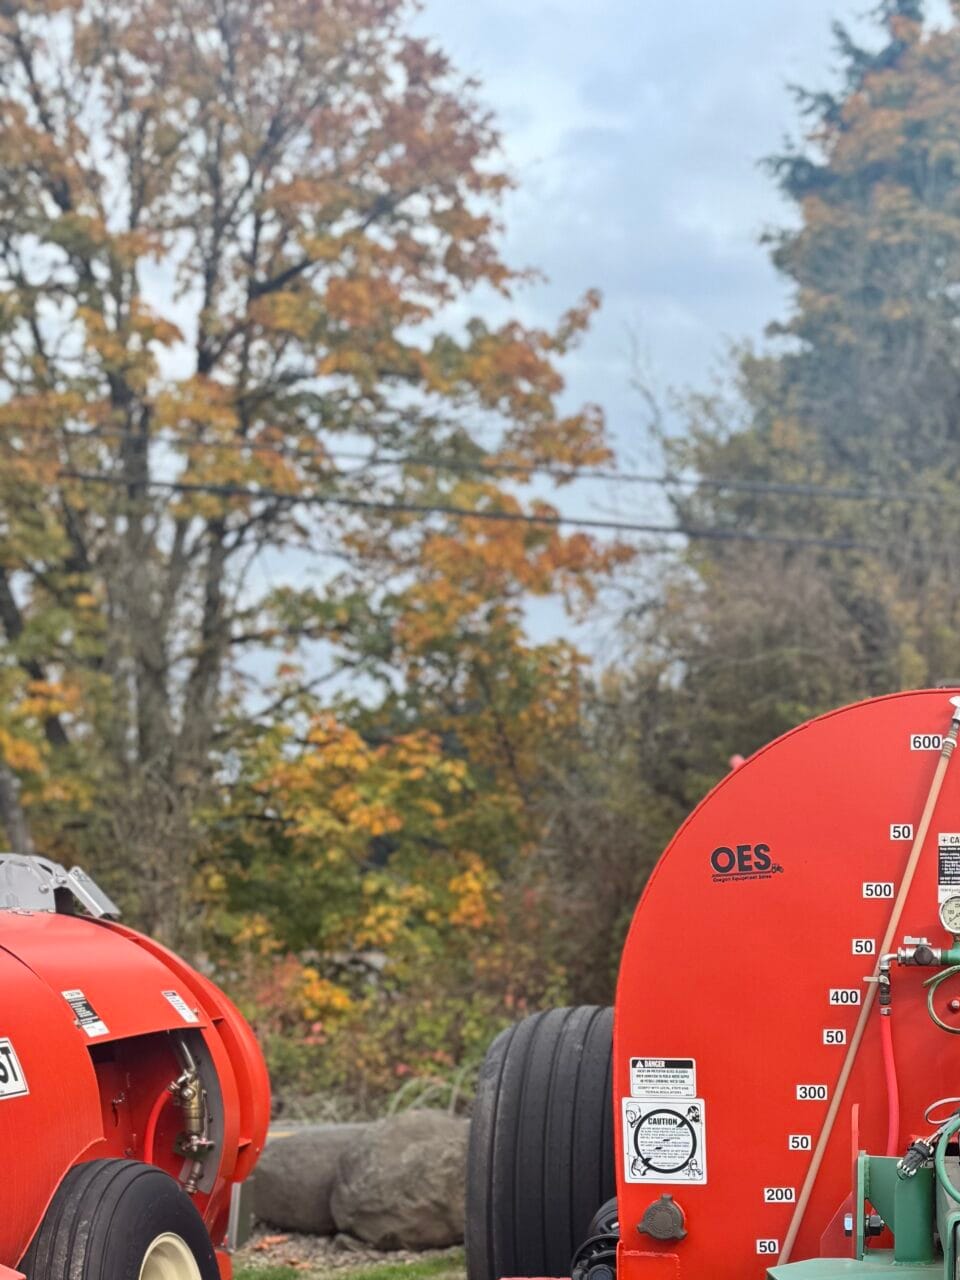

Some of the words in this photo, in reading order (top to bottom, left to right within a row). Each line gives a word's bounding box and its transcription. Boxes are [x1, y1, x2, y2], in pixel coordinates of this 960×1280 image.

[913, 736, 941, 749] 600
[892, 825, 911, 839] 50
[711, 844, 772, 873] OES
[865, 884, 892, 897] 500
[855, 940, 873, 953] 50
[831, 990, 858, 1003] 400
[826, 1030, 844, 1043] 50
[799, 1086, 826, 1099] 300
[648, 1117, 677, 1126] CAUTION
[791, 1136, 809, 1149] 50
[766, 1188, 793, 1201] 200
[759, 1240, 777, 1253] 50
